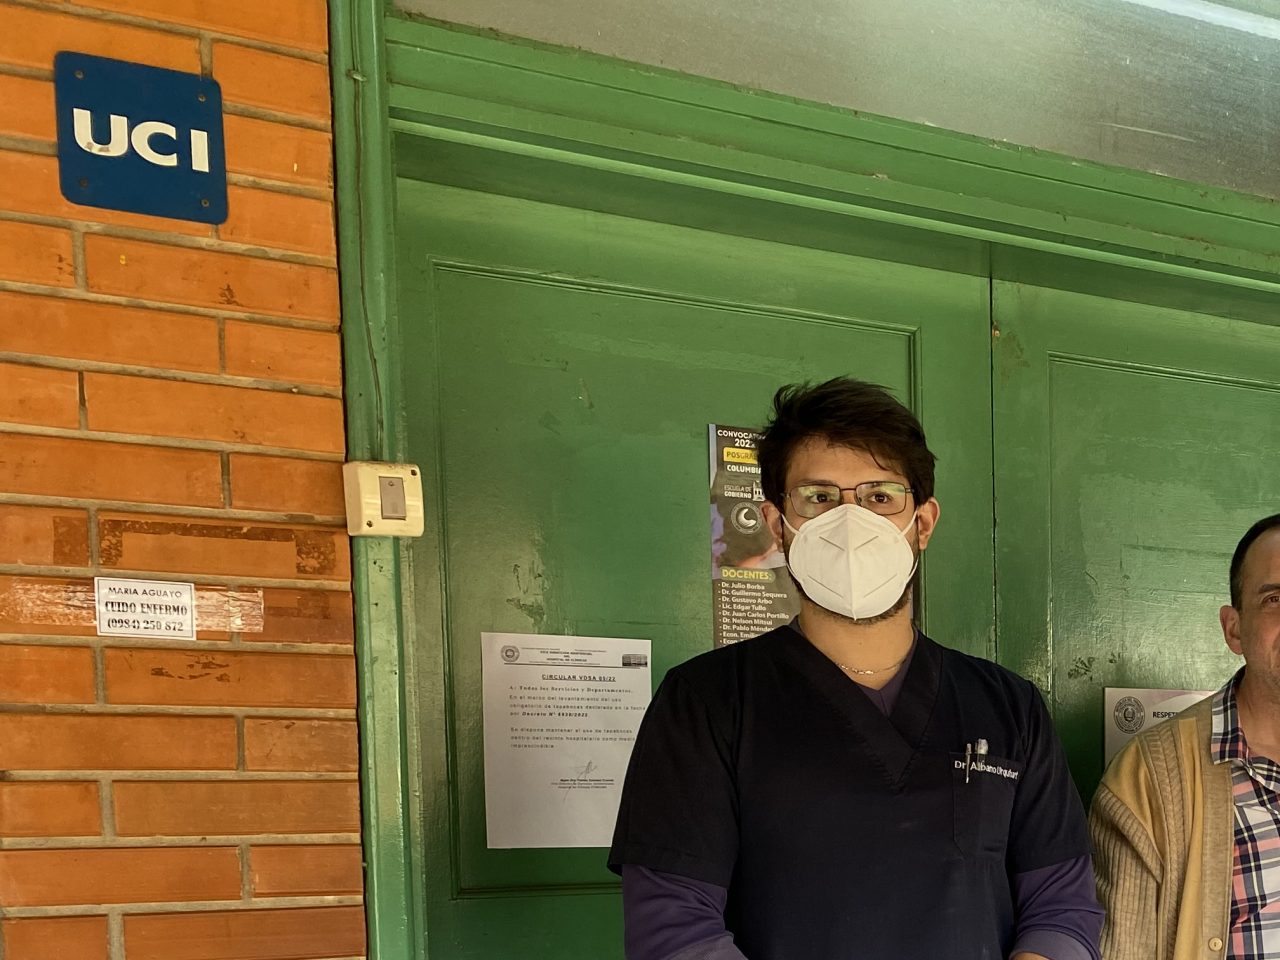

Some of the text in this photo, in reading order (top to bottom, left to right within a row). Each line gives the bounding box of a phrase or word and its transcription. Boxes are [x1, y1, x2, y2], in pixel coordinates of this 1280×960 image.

[73, 107, 210, 173] UCI
[724, 491, 752, 499] GOBIERNO
[108, 587, 182, 598] MARIA AGUAYO
[731, 596, 756, 604] Gustavo
[104, 600, 188, 616] CUIDO ENFERMO
[542, 673, 577, 681] CIRCULAR
